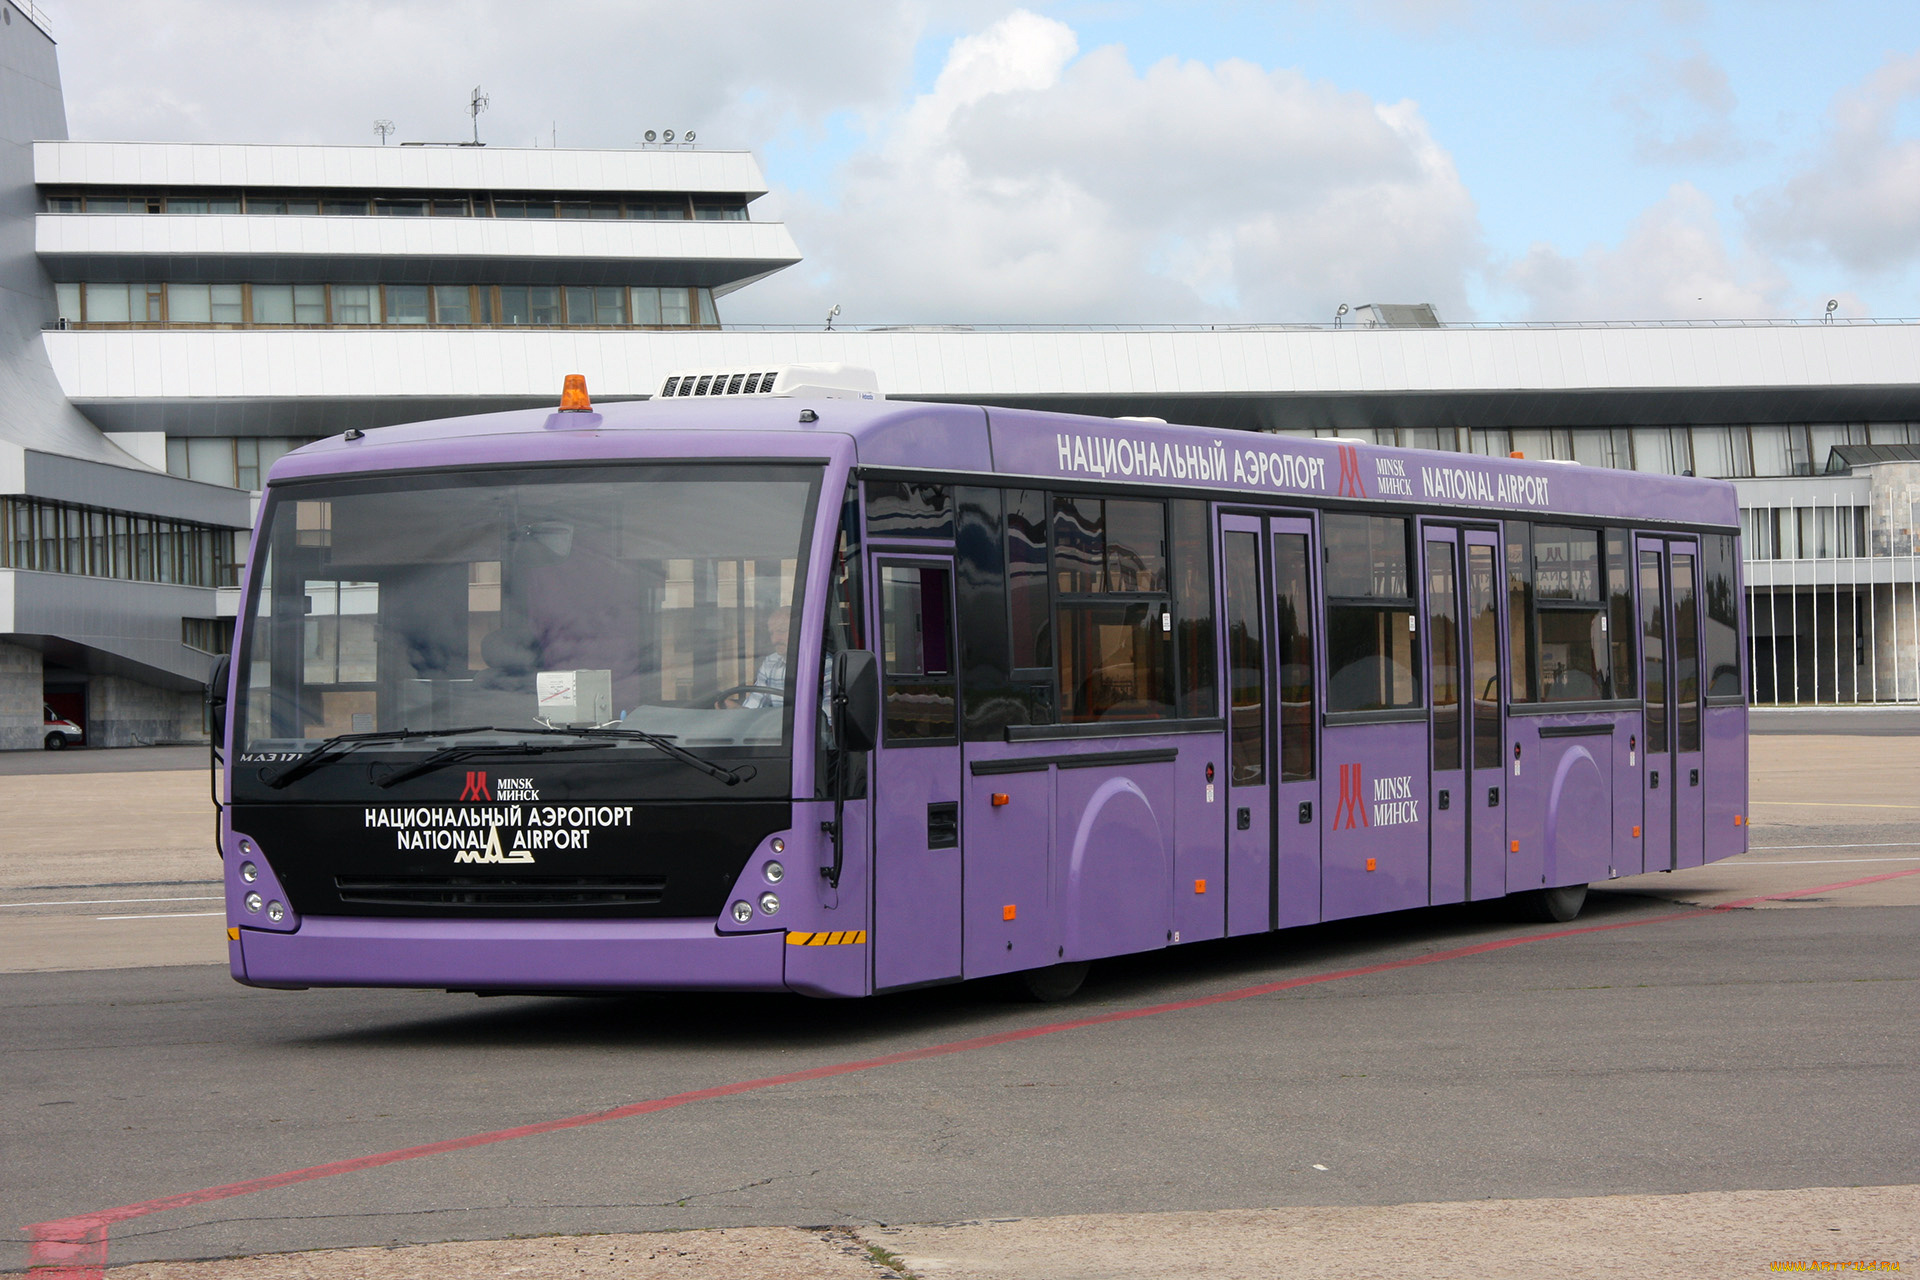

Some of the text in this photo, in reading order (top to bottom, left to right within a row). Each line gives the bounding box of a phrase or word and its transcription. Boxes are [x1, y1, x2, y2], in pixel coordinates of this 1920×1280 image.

[1056, 433, 1326, 490] НАЦИОНАЛЬНЫЙ АЭРОПОРТ
[1375, 458, 1406, 477] MINSK
[1377, 477, 1413, 496] МИНСК
[1422, 466, 1549, 506] NATIONAL AIRPORT
[496, 789, 540, 801] МИНСК
[497, 778, 534, 790] MINSK
[1373, 776, 1412, 802] MINSK
[365, 804, 633, 830] НАЦИОНАЛЬНЫЙ АЭРОПОРТ
[1373, 800, 1419, 827] МИНСК
[397, 829, 590, 850] NATIONAL AIRPORT
